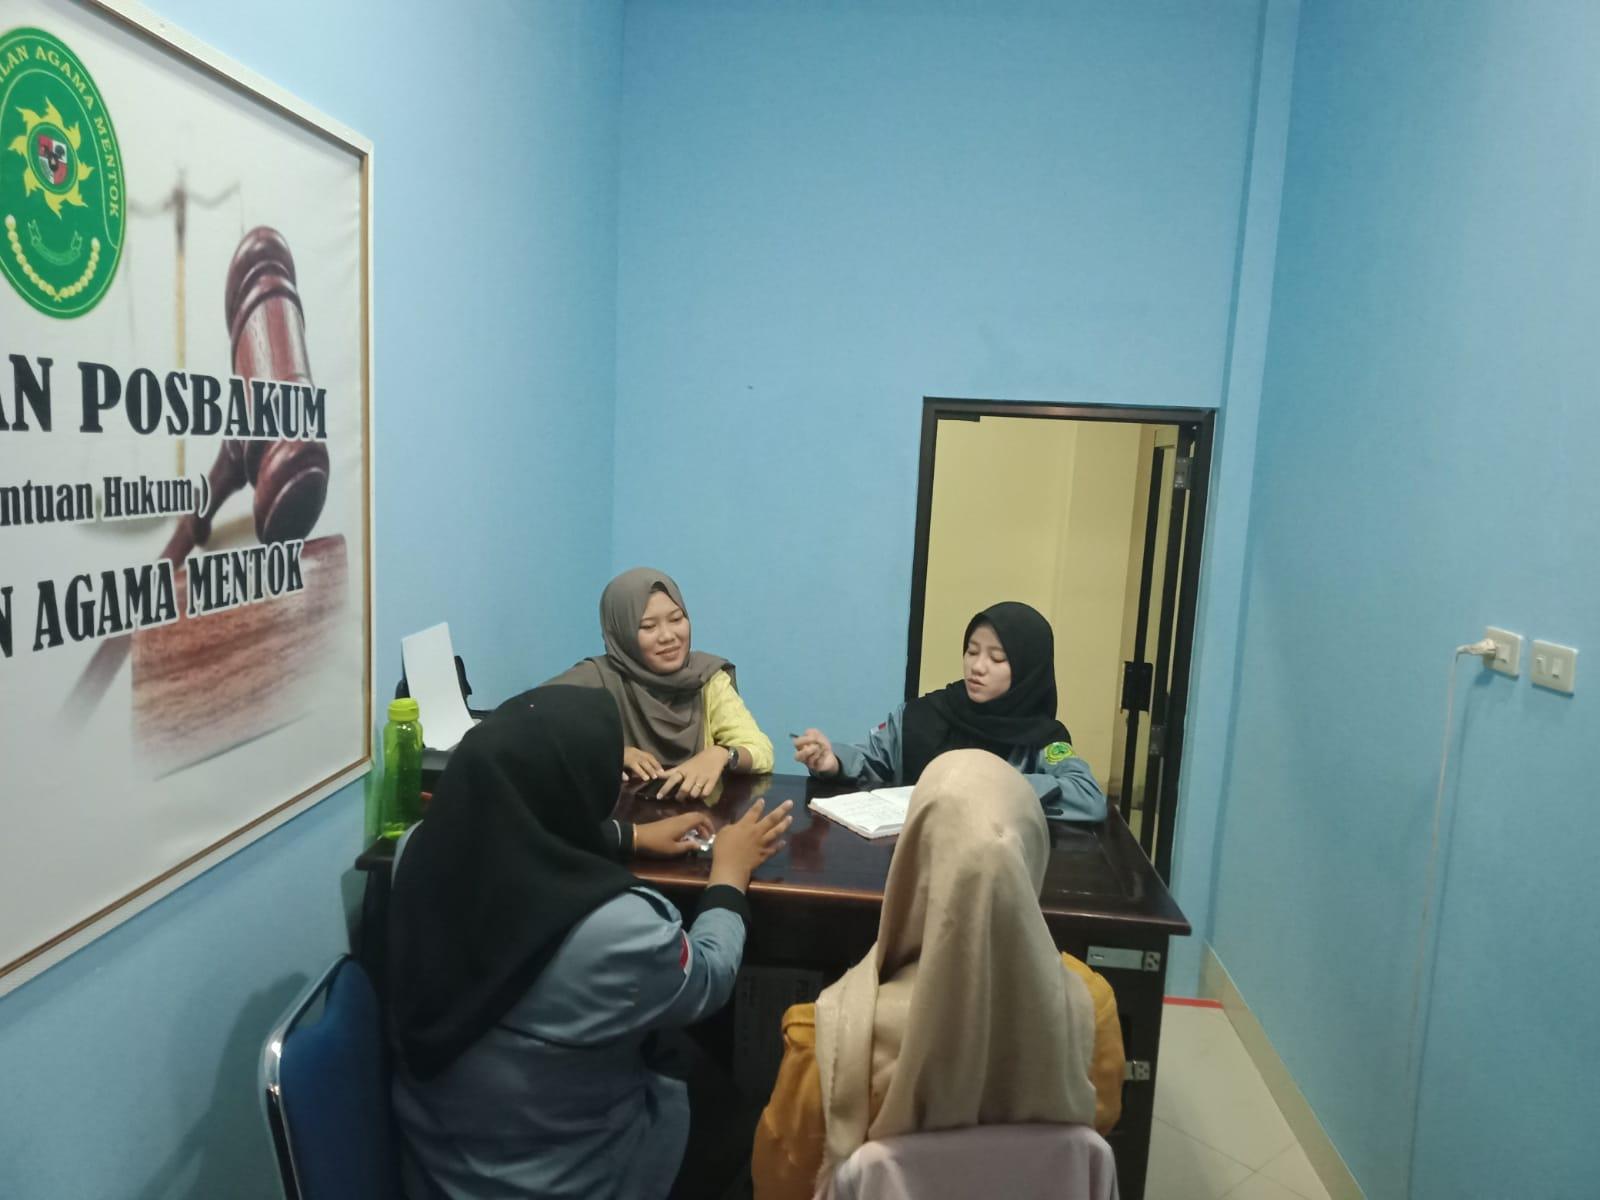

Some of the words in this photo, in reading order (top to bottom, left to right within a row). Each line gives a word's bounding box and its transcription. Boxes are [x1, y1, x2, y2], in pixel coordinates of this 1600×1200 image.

[36, 46, 94, 111] AGAMA
[94, 117, 119, 218] MENTOK
[78, 361, 327, 439] POSBAKUM
[33, 562, 178, 652] AGAMA
[188, 542, 304, 615] MENTOK
